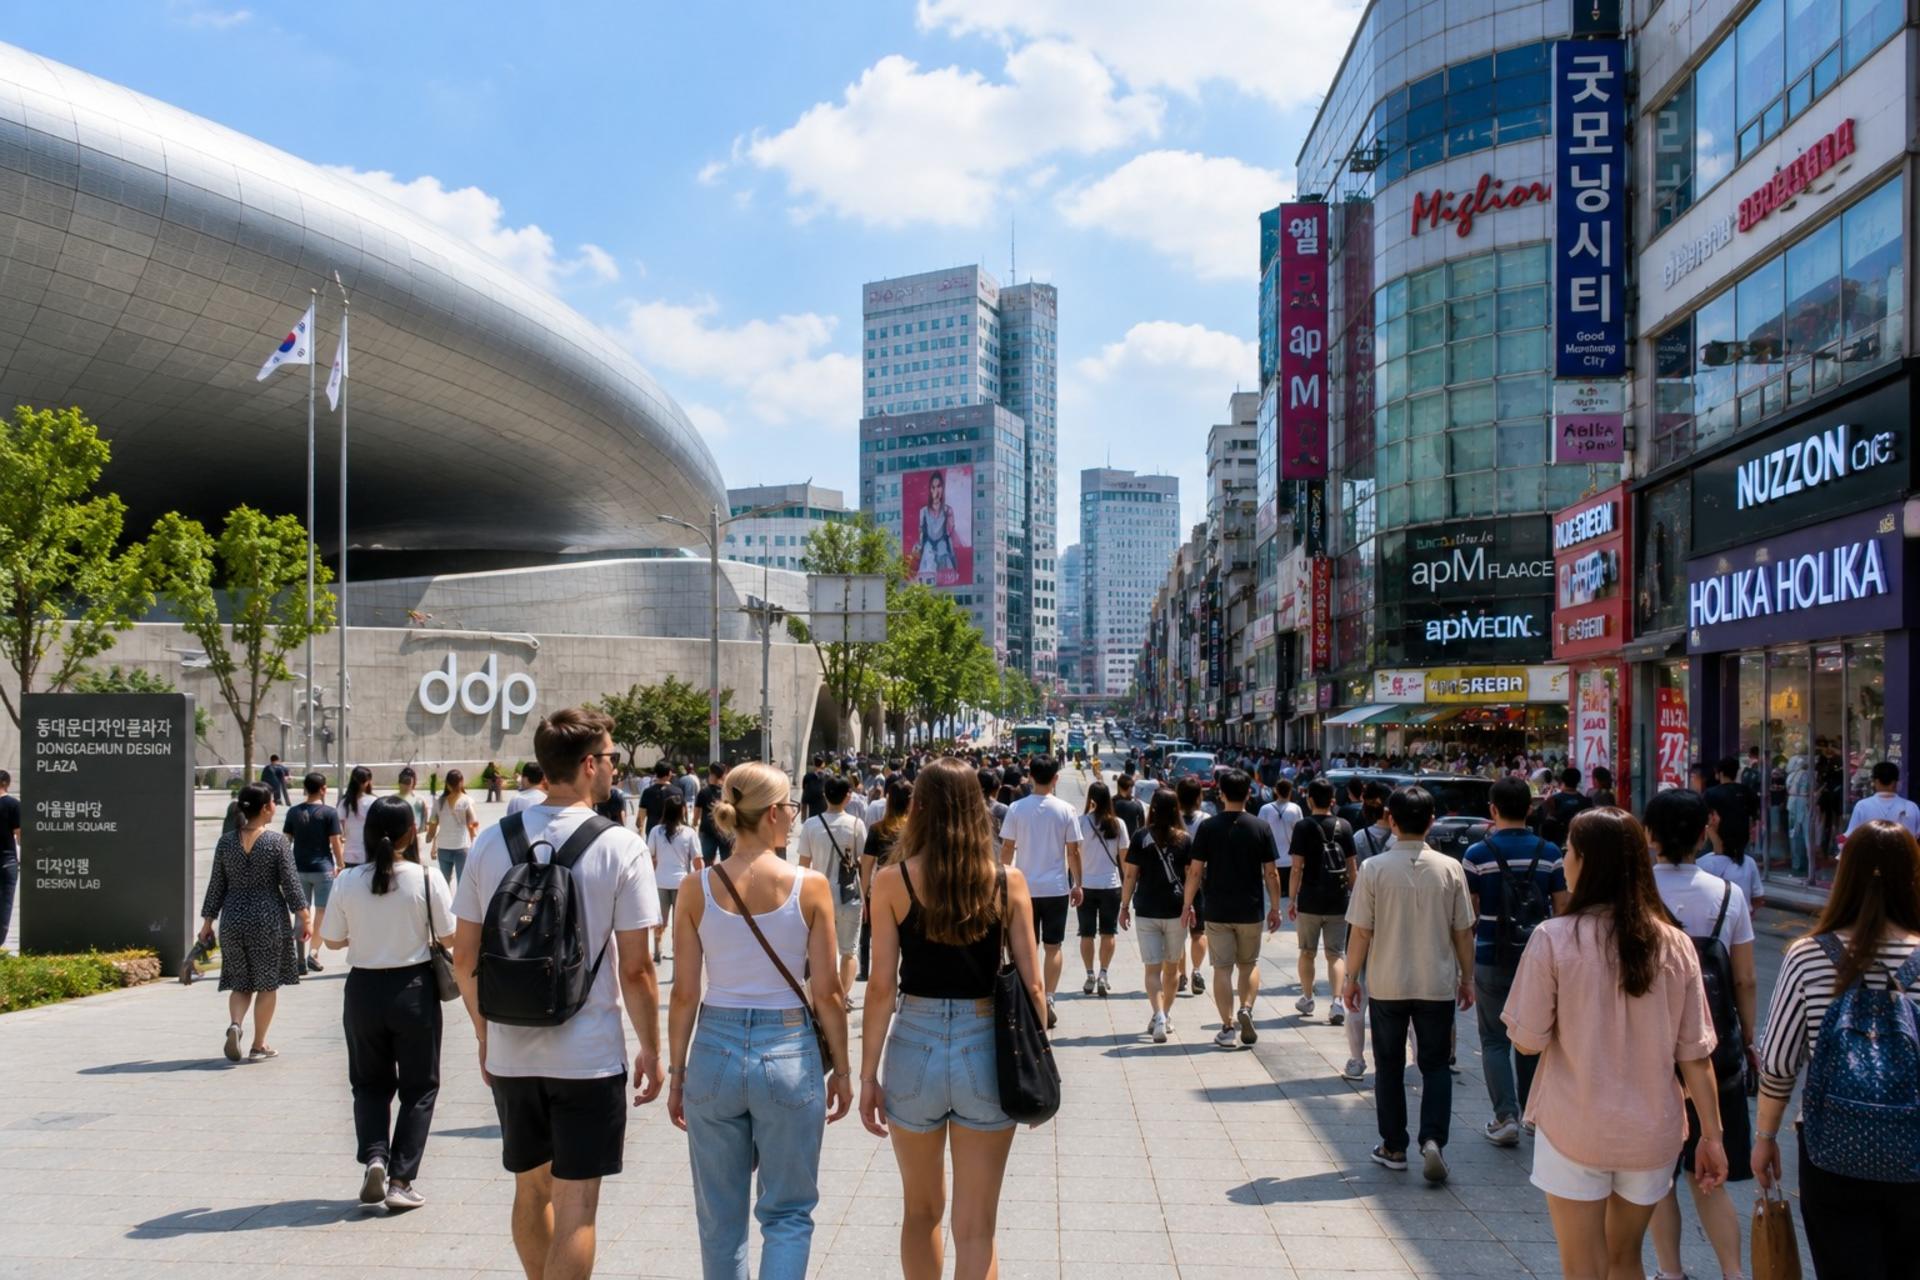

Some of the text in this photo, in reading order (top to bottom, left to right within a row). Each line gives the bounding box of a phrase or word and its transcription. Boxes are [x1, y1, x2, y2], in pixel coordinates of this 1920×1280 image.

[1411, 173, 1551, 237] Miglior
[1567, 55, 1614, 323] 굿모닝시티
[1576, 331, 1605, 341] Good
[1738, 425, 1845, 510] NUZZON
[1412, 547, 1484, 592] apM
[1691, 566, 1770, 627] HOLIKA
[1777, 539, 1884, 613] HOLIKA
[419, 653, 537, 730] ddp
[126, 742, 172, 755] DESIGN
[76, 821, 118, 832] SQUARE
[36, 878, 77, 889] DESIGN
